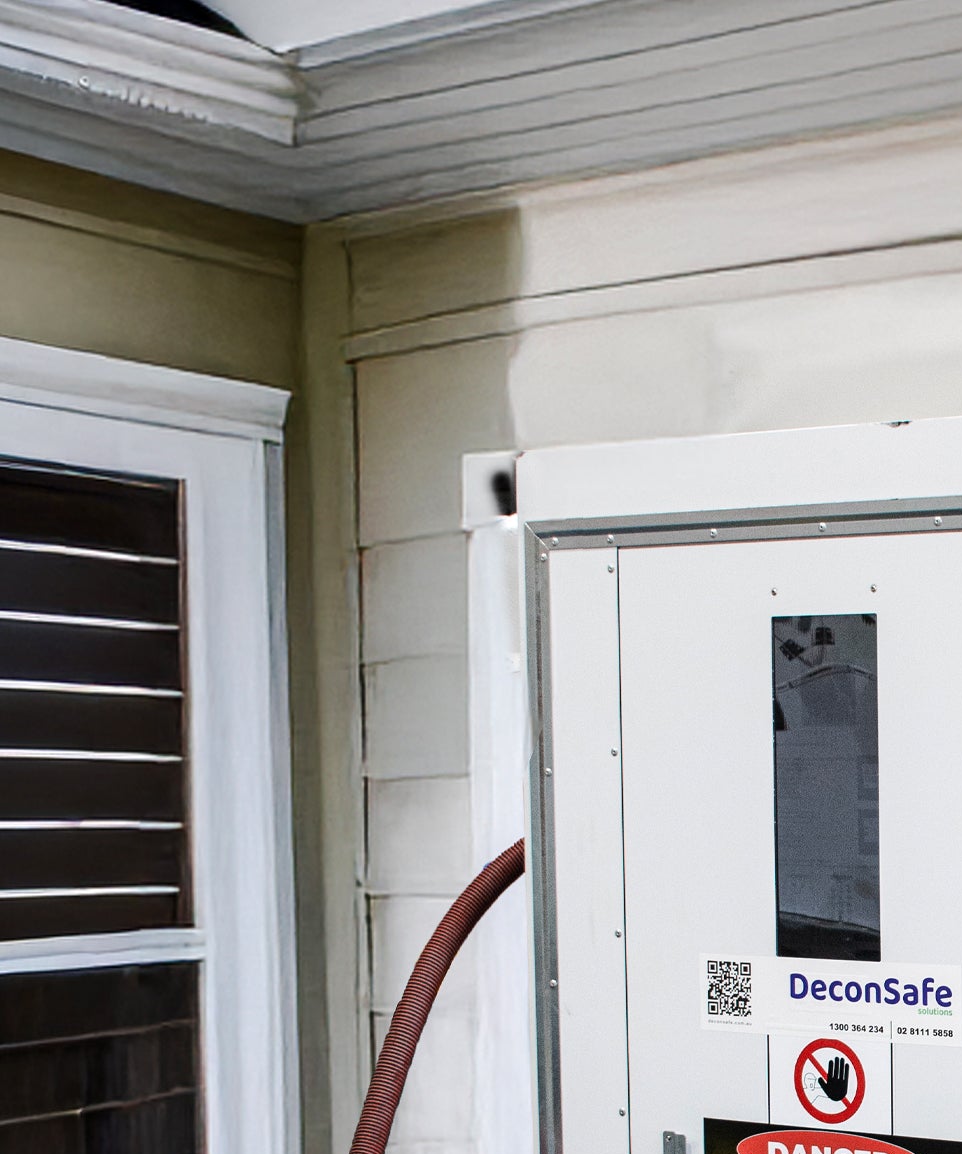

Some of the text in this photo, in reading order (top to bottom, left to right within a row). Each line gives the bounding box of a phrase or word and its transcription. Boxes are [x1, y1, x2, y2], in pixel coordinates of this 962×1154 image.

[790, 973, 953, 1008] DeconSafe
[917, 1007, 953, 1017] solutions
[829, 1023, 884, 1034] 1300 364 234
[897, 1026, 954, 1038] 02 8111 5858
